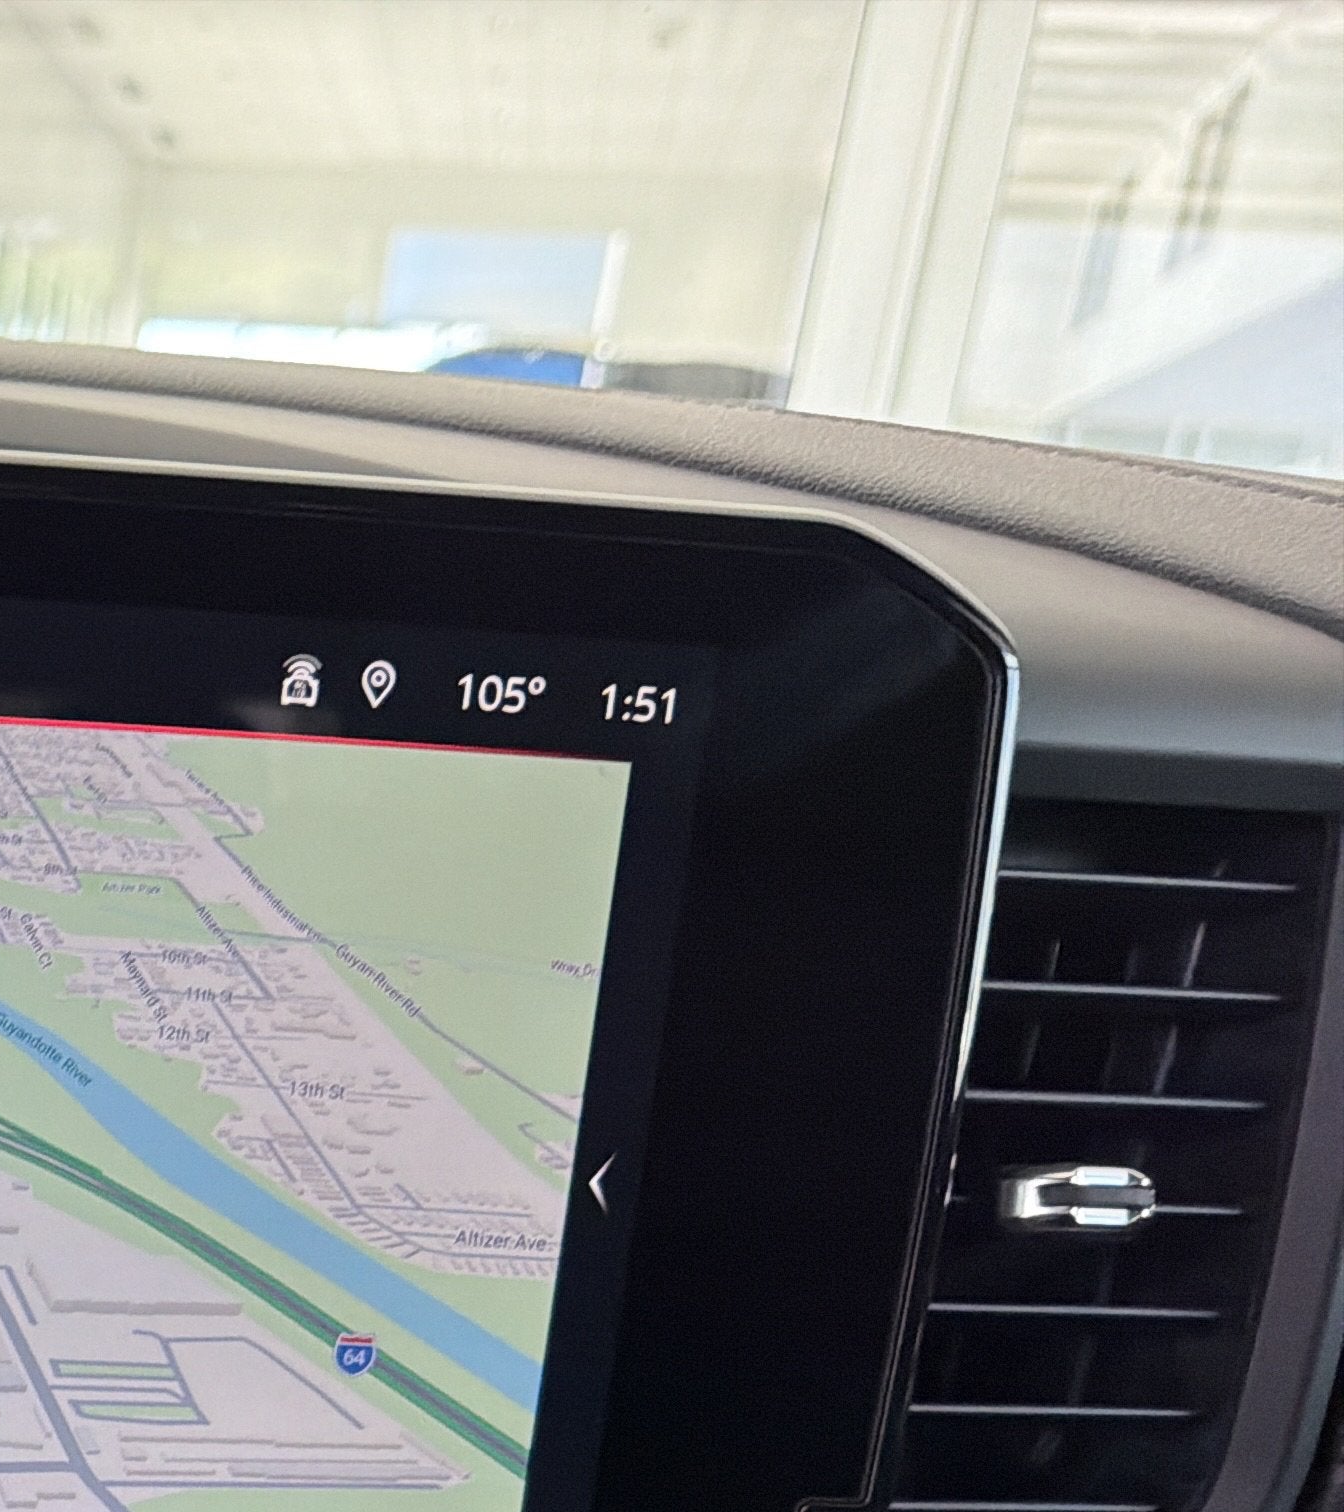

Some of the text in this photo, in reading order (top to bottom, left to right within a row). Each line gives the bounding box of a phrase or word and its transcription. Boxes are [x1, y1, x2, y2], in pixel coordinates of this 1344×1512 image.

[600, 684, 678, 725] 1:51
[0, 906, 13, 919] St
[20, 913, 53, 970] Galvin Ct
[162, 950, 209, 966] 10th St
[120, 951, 169, 1023] Maynard St
[336, 944, 422, 1018] Guyan River Rd
[185, 987, 233, 1003] 11th St
[157, 1025, 210, 1043] 12th St
[60, 1057, 92, 1088] River
[288, 1080, 346, 1100] 13th St
[454, 1228, 548, 1252] Altizer Ave
[343, 1348, 367, 1367] 64
